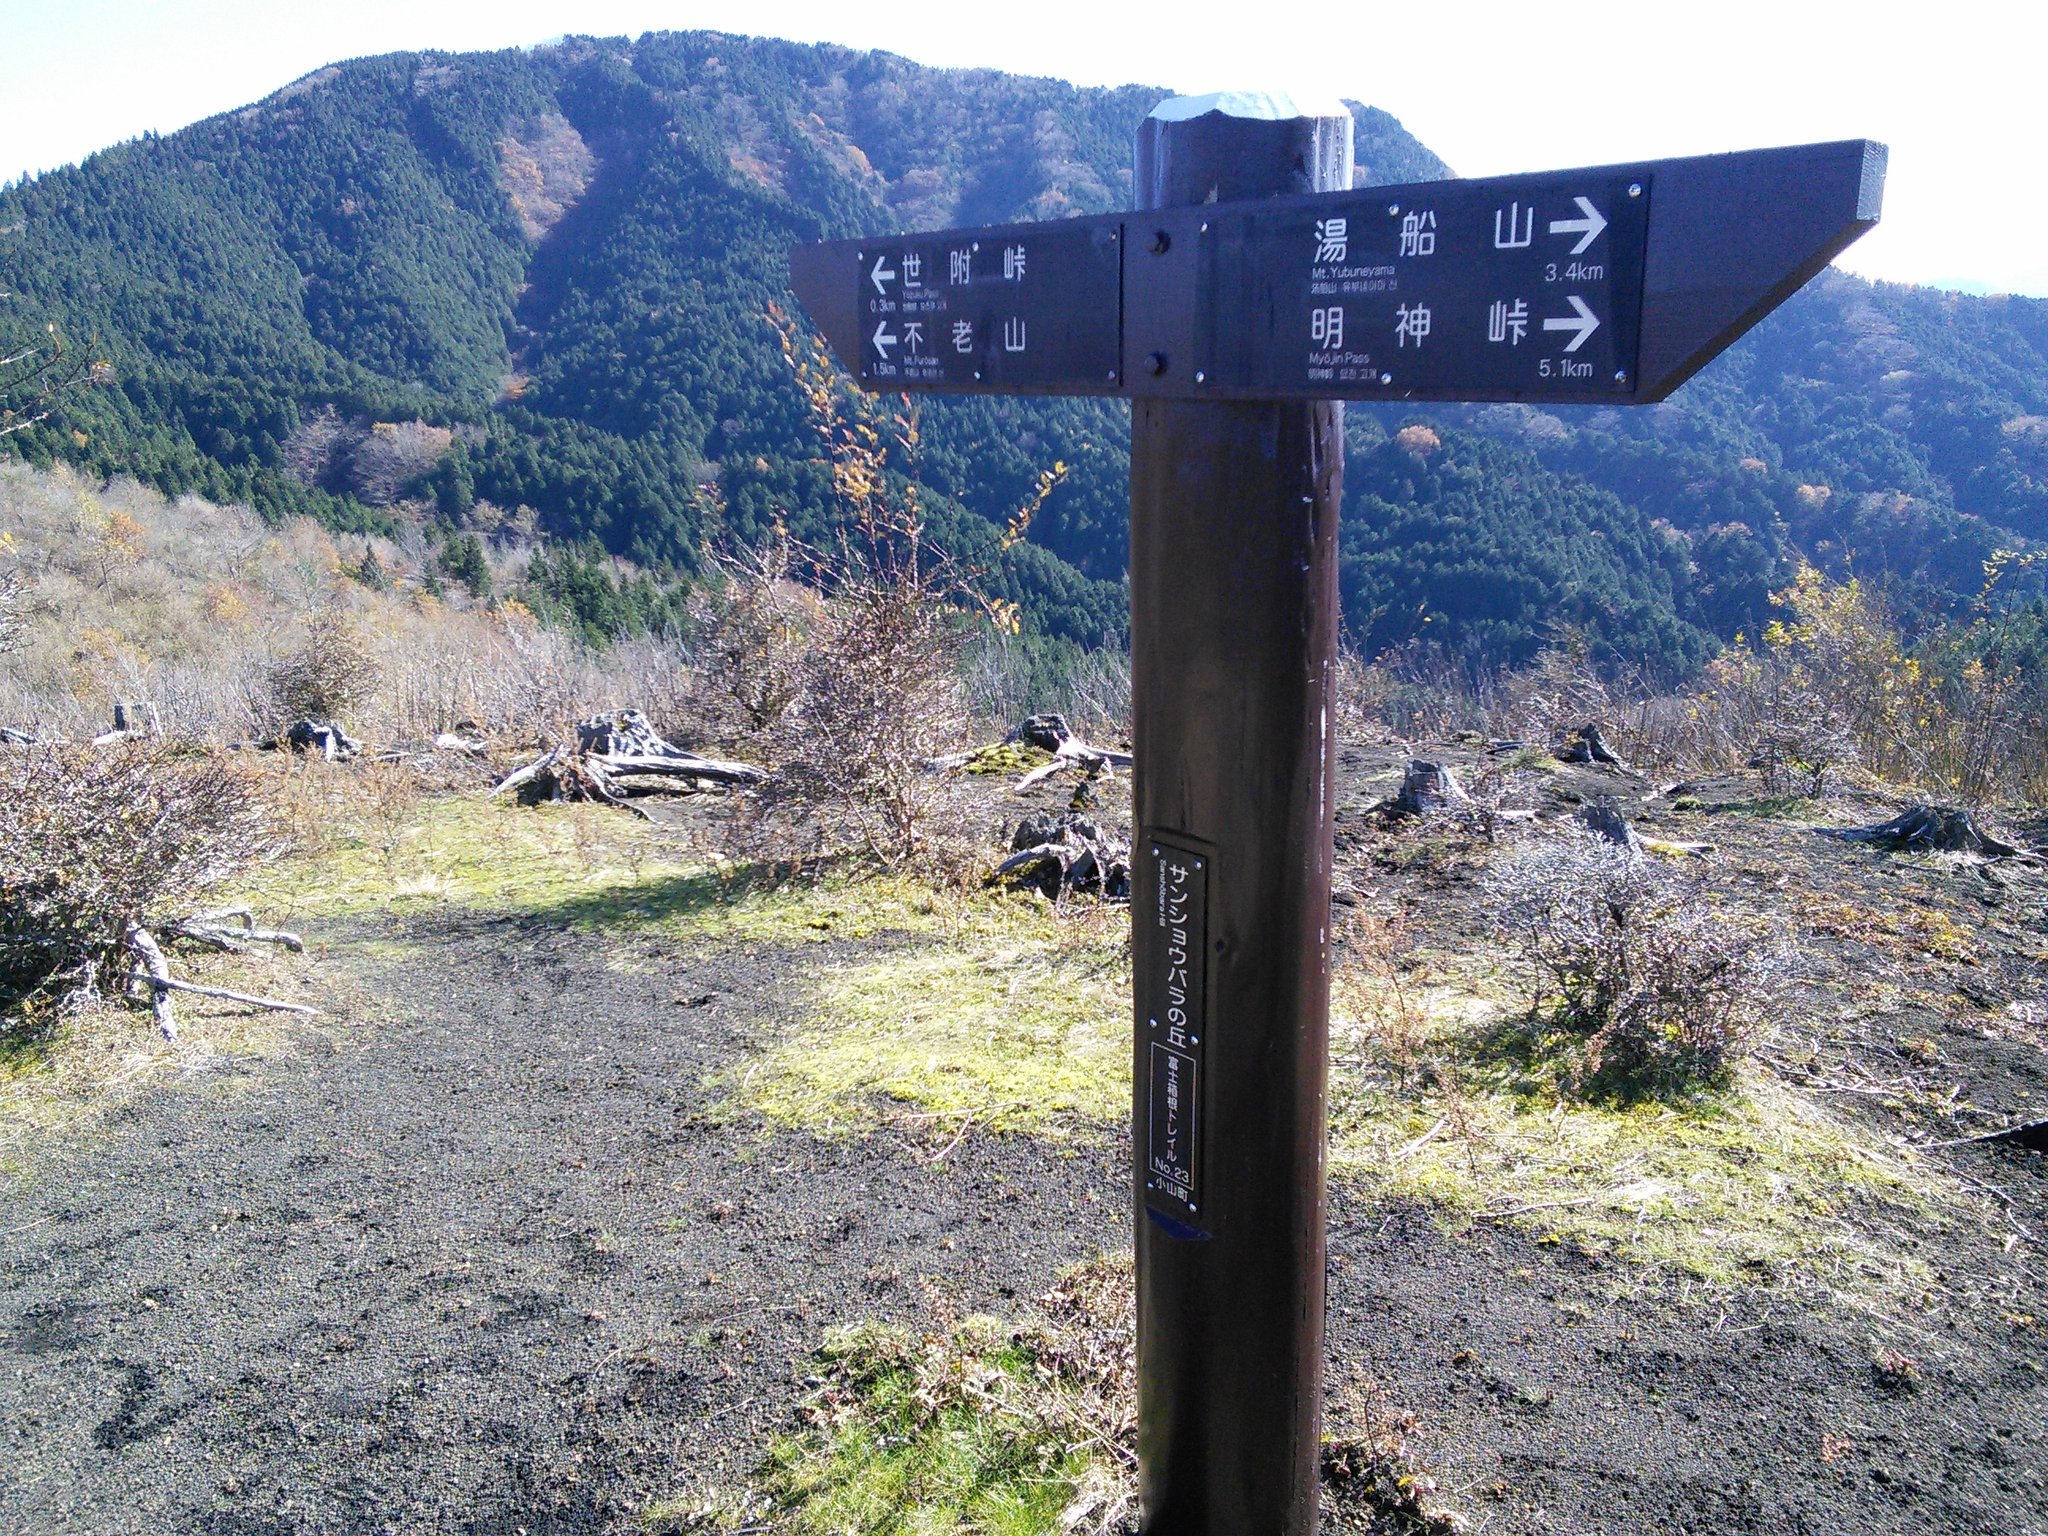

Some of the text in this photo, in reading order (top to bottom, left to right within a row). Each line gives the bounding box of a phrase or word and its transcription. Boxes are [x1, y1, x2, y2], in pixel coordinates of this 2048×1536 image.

[1314, 200, 1534, 263] 湯船山
[902, 244, 1026, 288] 世附峠
[1545, 261, 1604, 282] 3.4km
[870, 299, 896, 313] 0.3km
[903, 316, 1026, 354] 不老山
[1311, 298, 1529, 349] 明神峠
[872, 362, 897, 376] 1.5km
[1538, 358, 1593, 377] 5.1km
[1167, 863, 1189, 1049] サンショウバラの丘
[1166, 1055, 1179, 1162] 富士箱根トレイル
[1154, 1156, 1190, 1183] No.23
[1155, 1177, 1189, 1203] 小山町
